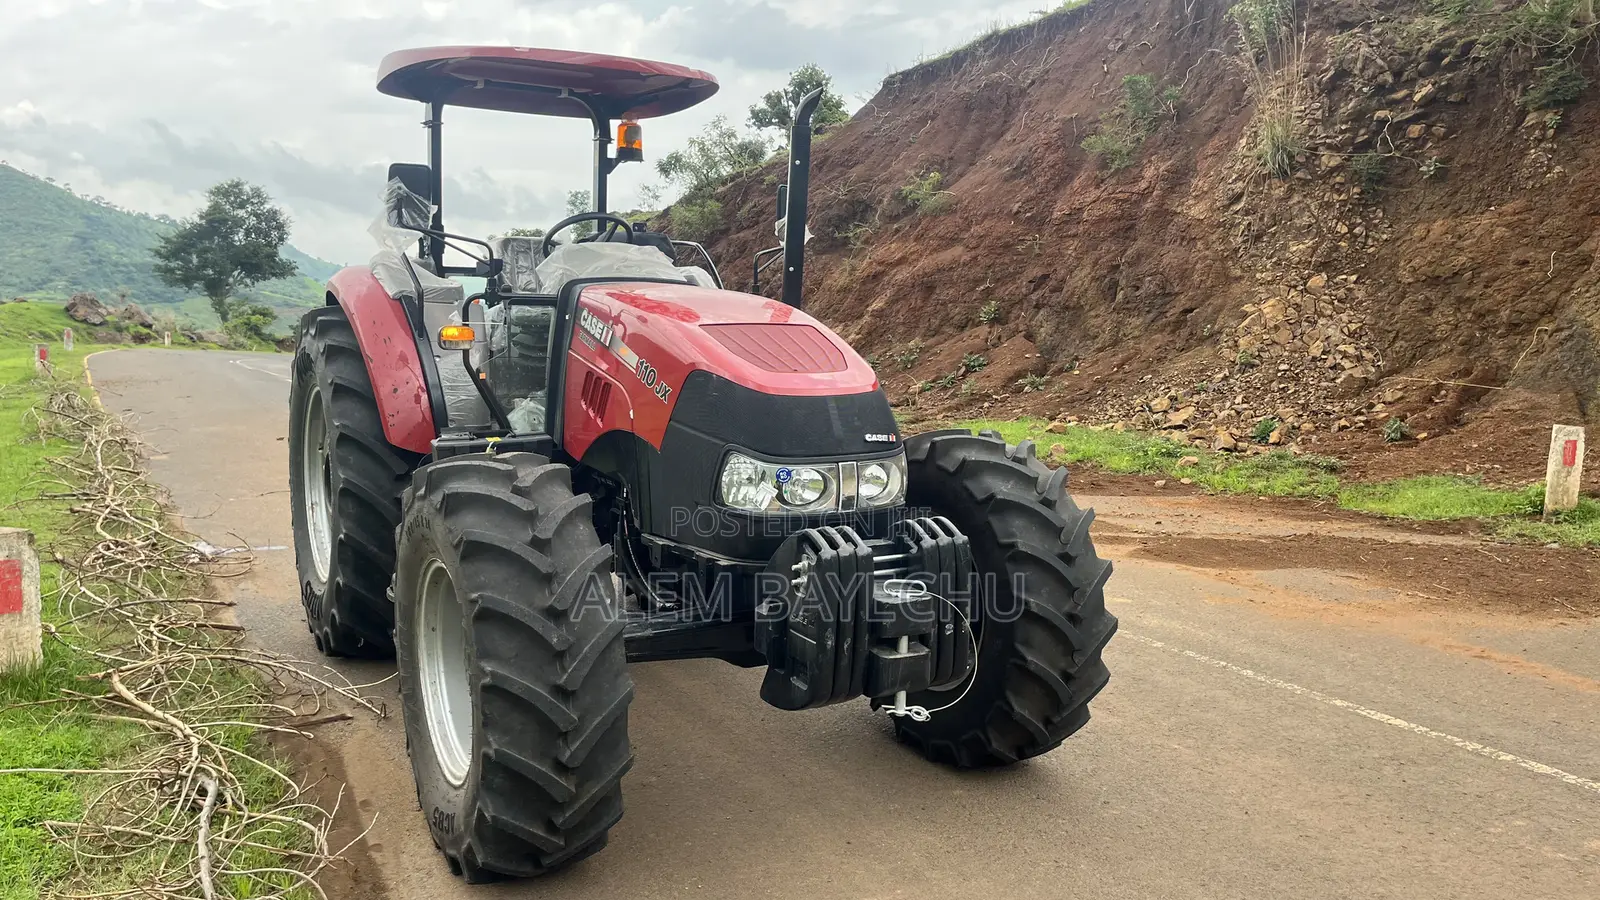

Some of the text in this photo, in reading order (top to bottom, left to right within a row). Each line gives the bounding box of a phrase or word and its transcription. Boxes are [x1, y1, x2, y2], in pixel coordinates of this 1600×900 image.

[580, 308, 603, 340] CASE
[637, 359, 672, 404] 110 JX
[864, 433, 888, 442] CASE
